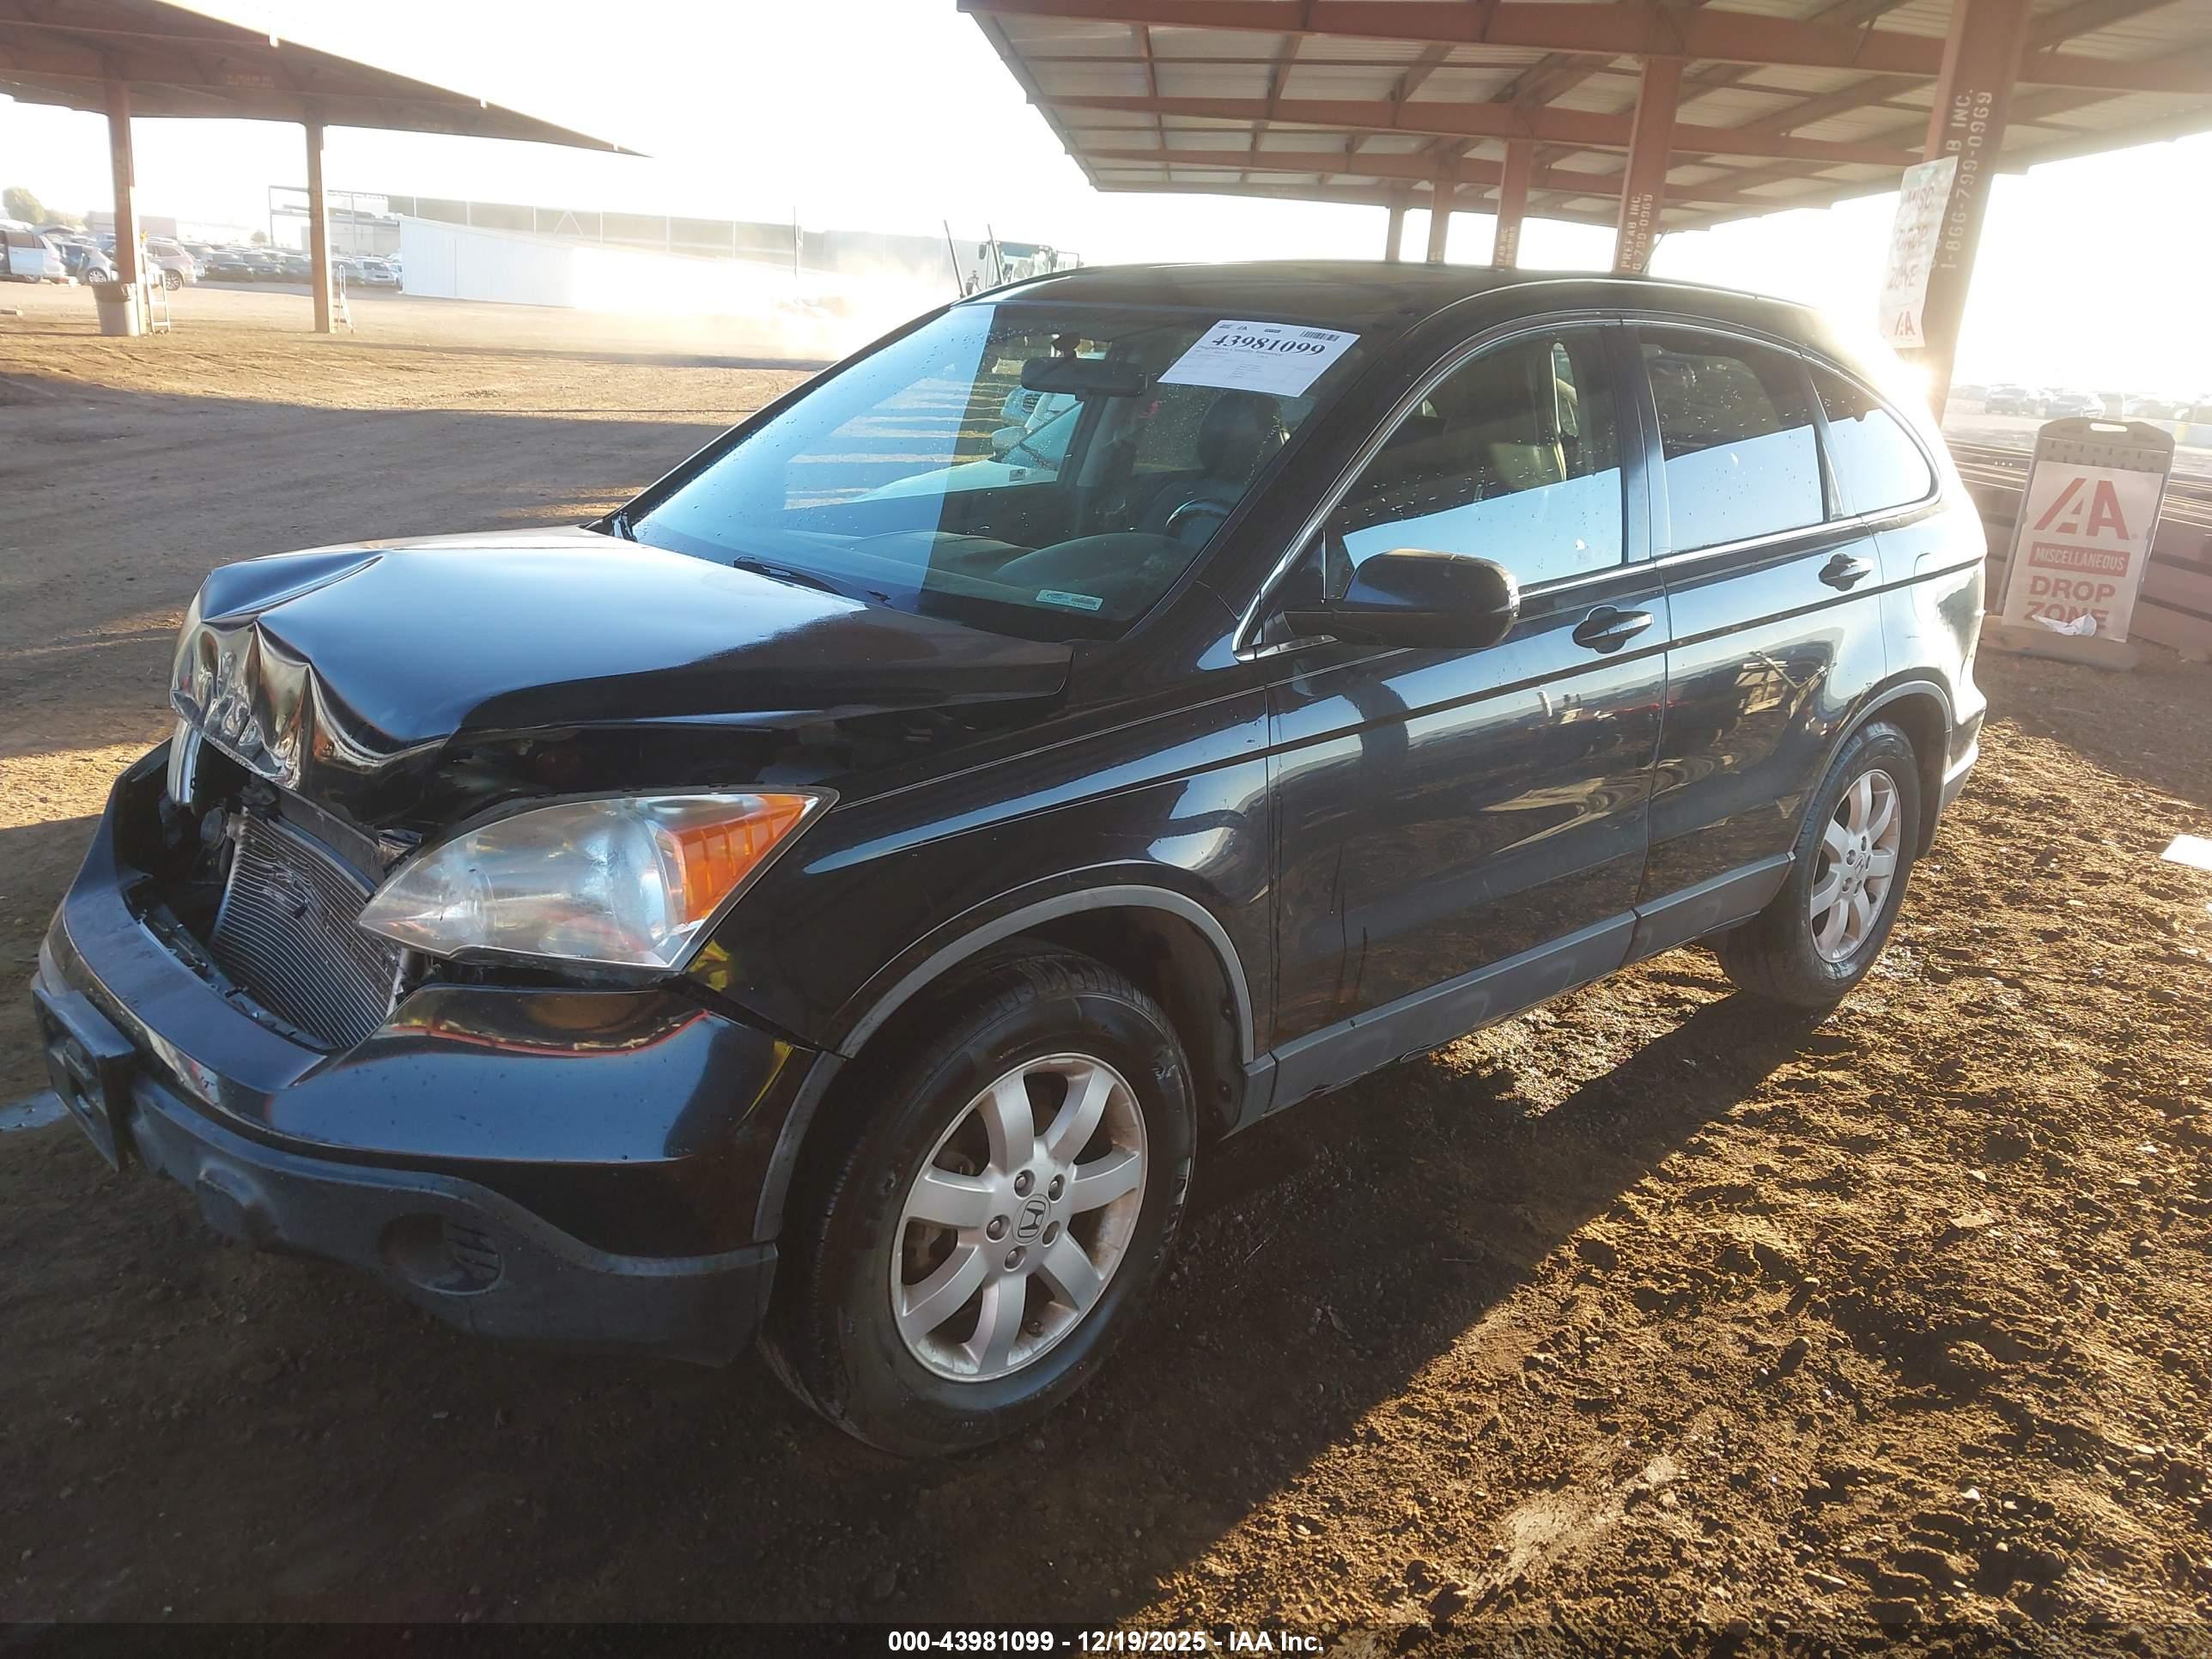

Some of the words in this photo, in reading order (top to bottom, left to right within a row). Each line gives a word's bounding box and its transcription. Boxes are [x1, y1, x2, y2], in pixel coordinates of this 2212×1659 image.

[1951, 89, 1973, 129] INC.
[1941, 91, 1992, 270] 1-866-799-0969
[1212, 334, 1326, 356] 43981099
[2035, 548, 2125, 571] MISCELLANEOUS
[2029, 575, 2116, 603] DROP
[2023, 600, 2110, 630] ZONE
